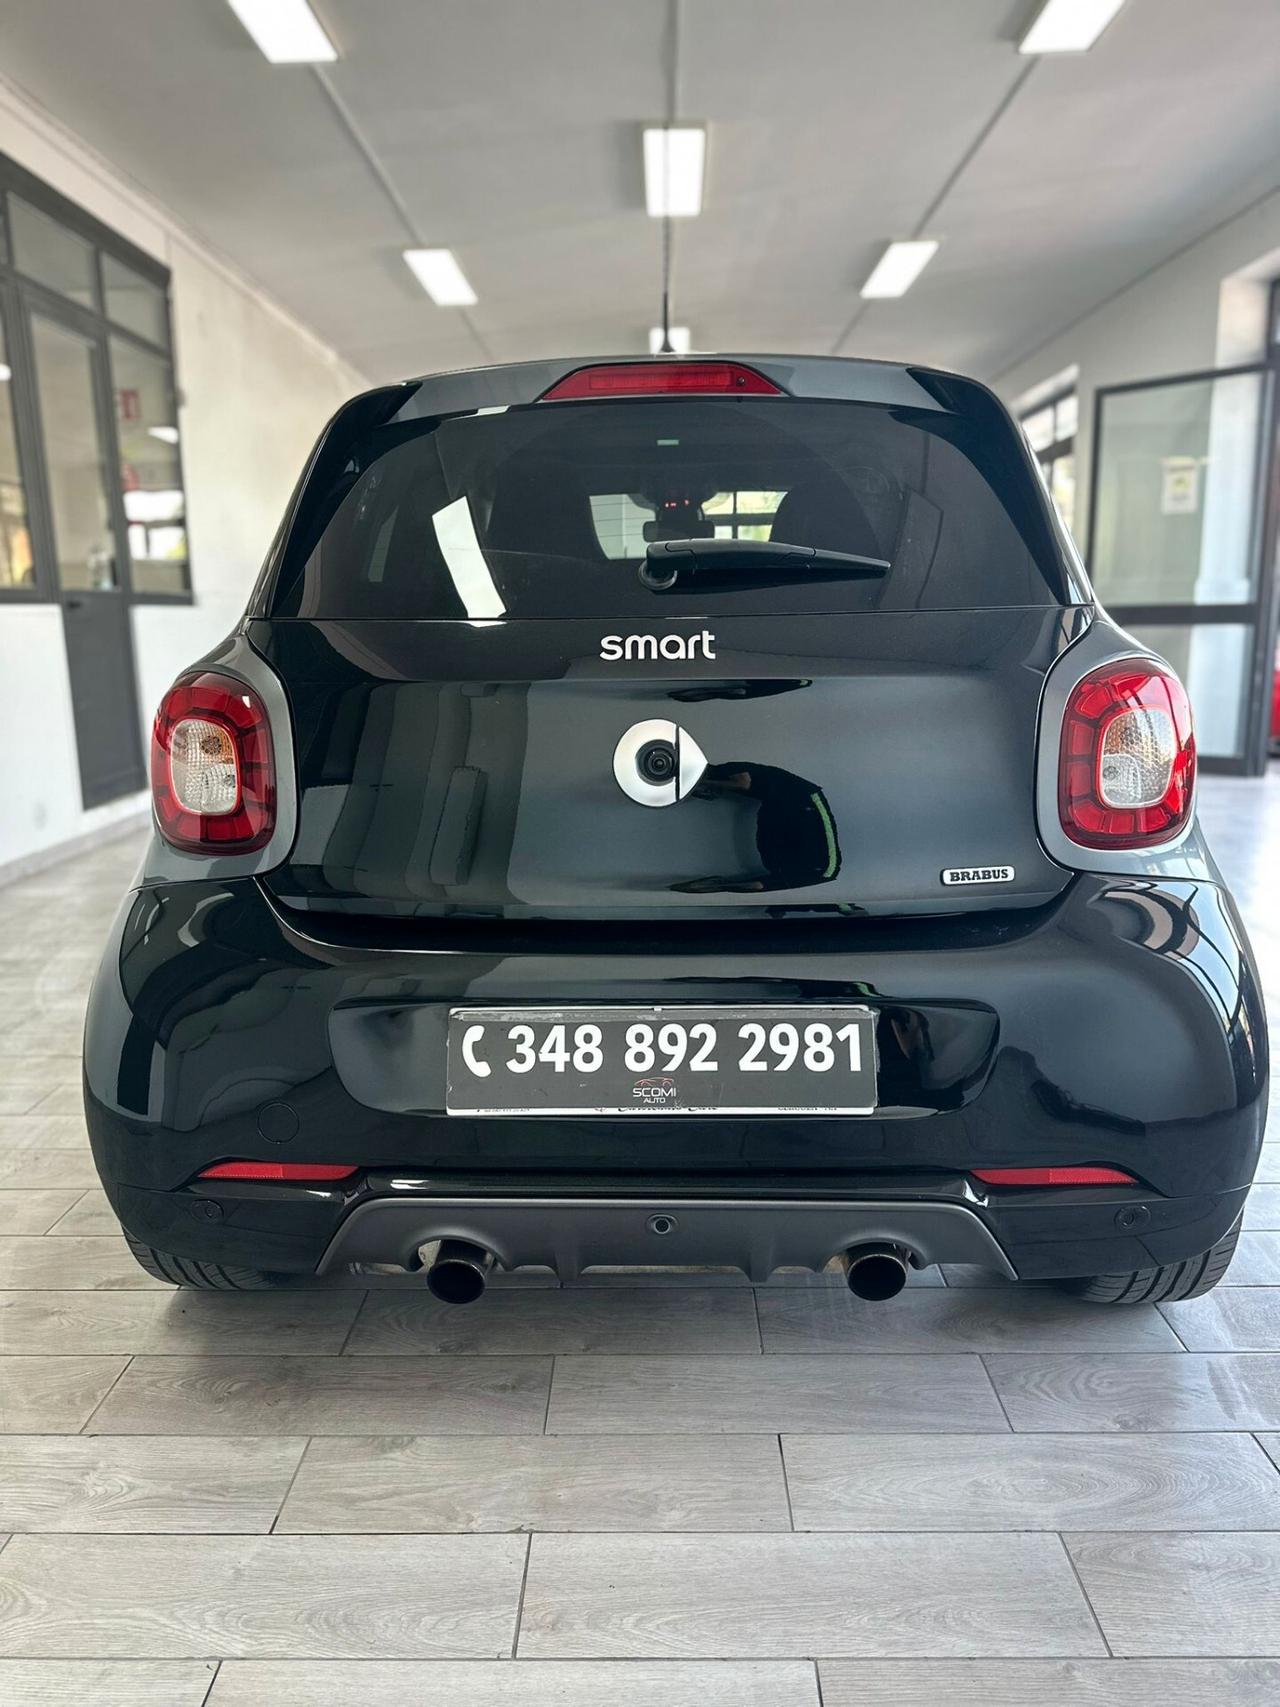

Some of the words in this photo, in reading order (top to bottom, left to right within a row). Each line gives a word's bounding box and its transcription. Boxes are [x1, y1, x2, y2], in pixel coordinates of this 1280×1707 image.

[600, 630, 716, 660] smart
[949, 869, 1009, 882] BRABUS
[506, 1024, 604, 1073] 348
[624, 1023, 719, 1072] 892
[738, 1023, 861, 1072] 2981
[632, 1087, 677, 1097] SCOMI
